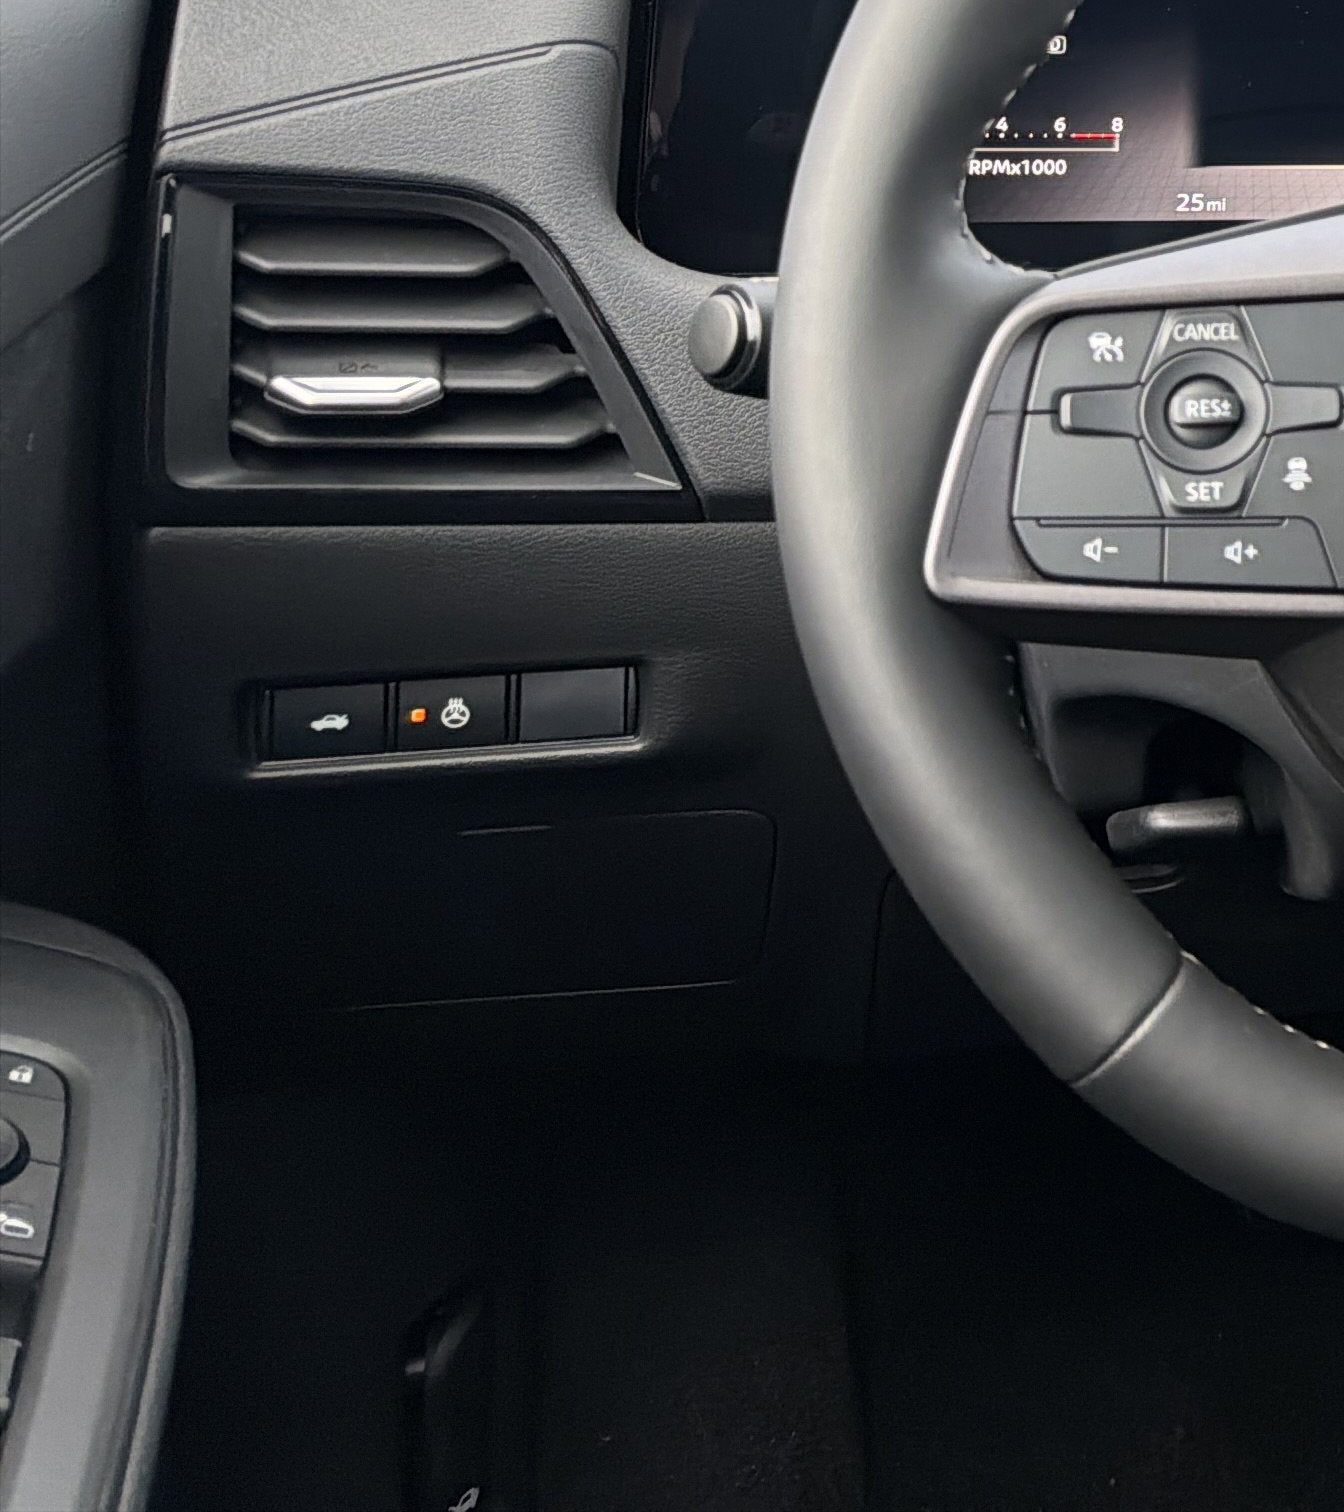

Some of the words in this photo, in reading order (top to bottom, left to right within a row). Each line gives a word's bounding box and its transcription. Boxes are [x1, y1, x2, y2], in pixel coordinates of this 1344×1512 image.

[996, 117, 1008, 132] 4
[1054, 117, 1066, 132] 6
[1112, 117, 1123, 132] 8
[968, 159, 1067, 176] RPMx1000
[1176, 194, 1204, 212] 25
[1207, 198, 1226, 212] mi
[1173, 323, 1239, 341] CANCEL
[1185, 482, 1223, 501] SET
